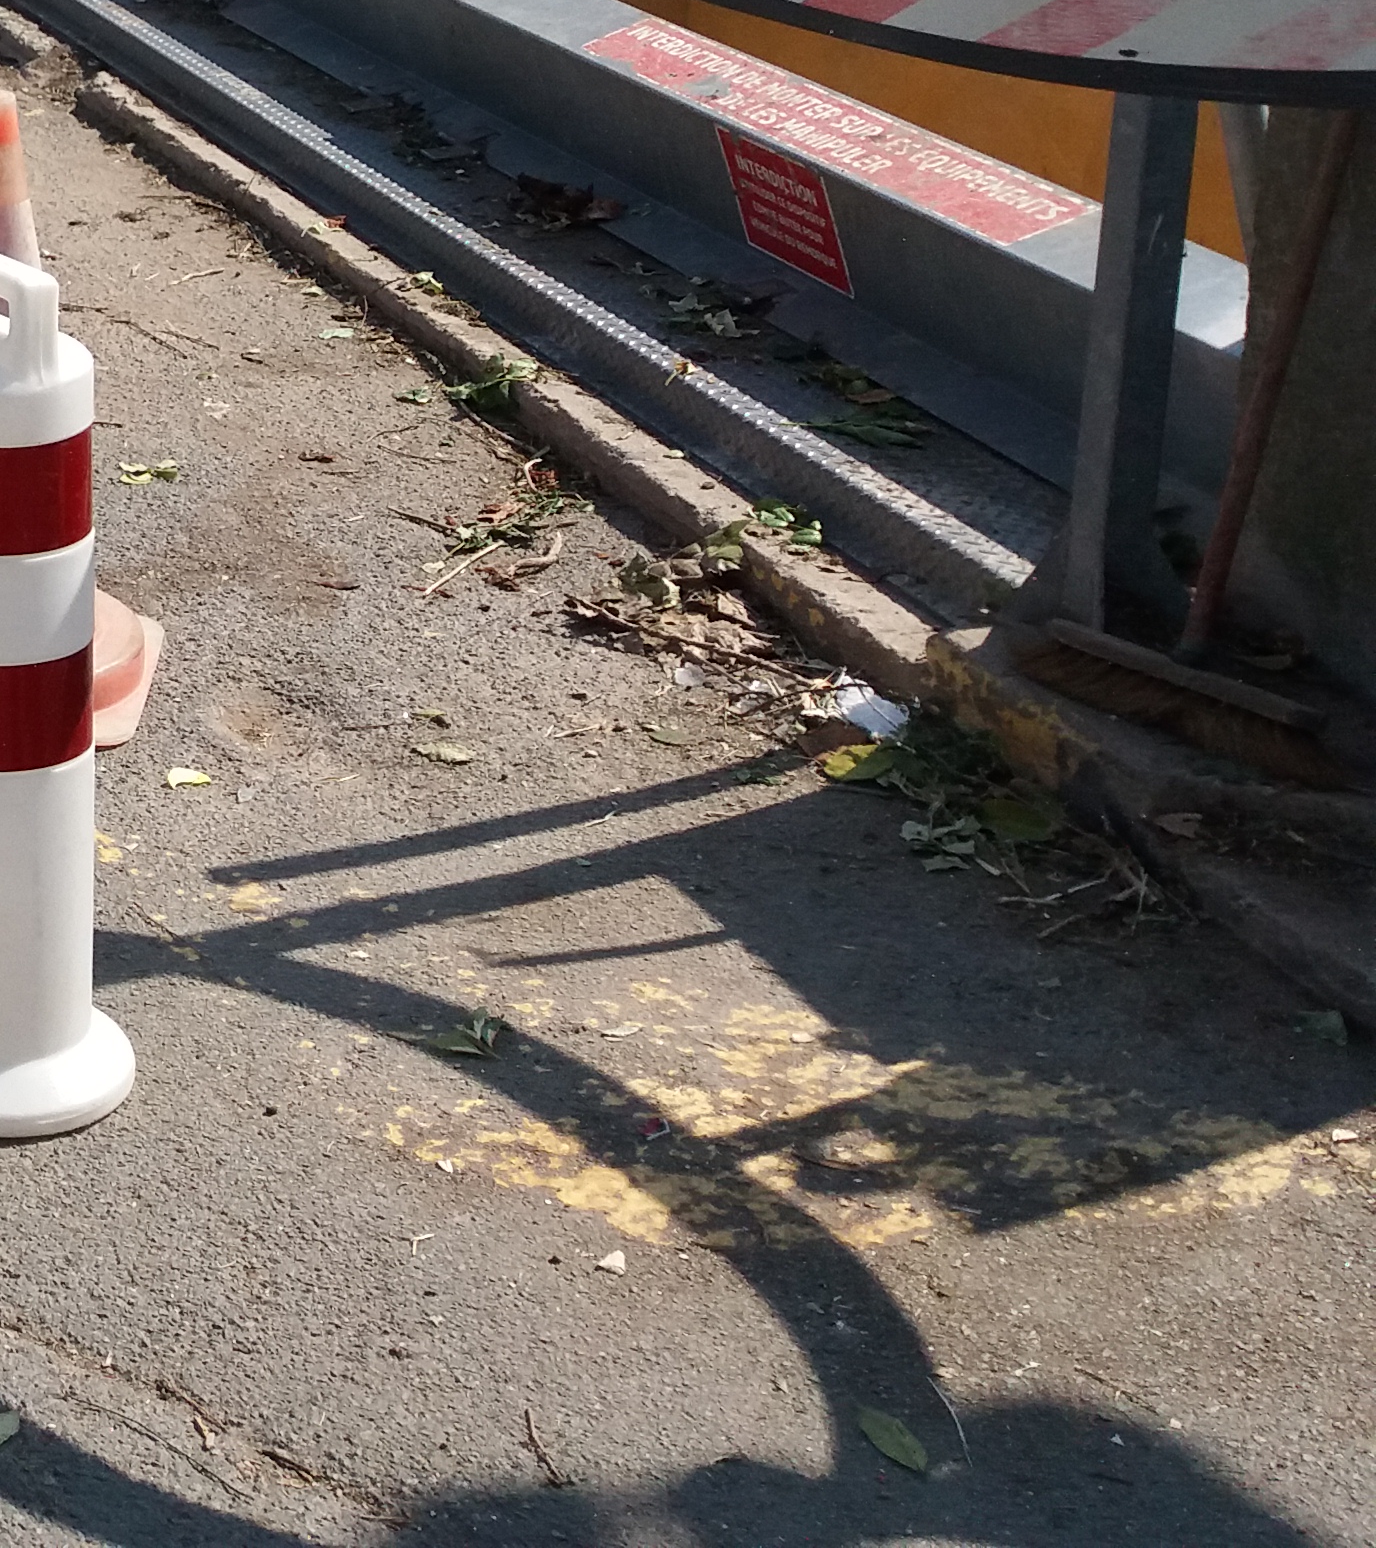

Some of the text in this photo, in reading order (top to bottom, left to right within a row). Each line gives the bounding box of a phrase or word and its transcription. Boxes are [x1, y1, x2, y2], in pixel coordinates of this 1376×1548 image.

[627, 25, 740, 80] INTERDICTION
[732, 69, 768, 90] DE
[755, 81, 843, 121] MONTER
[830, 114, 885, 141] SUR
[742, 103, 788, 125] LES
[771, 118, 894, 175] MANIPULER
[734, 153, 819, 207] INTERDICTION
